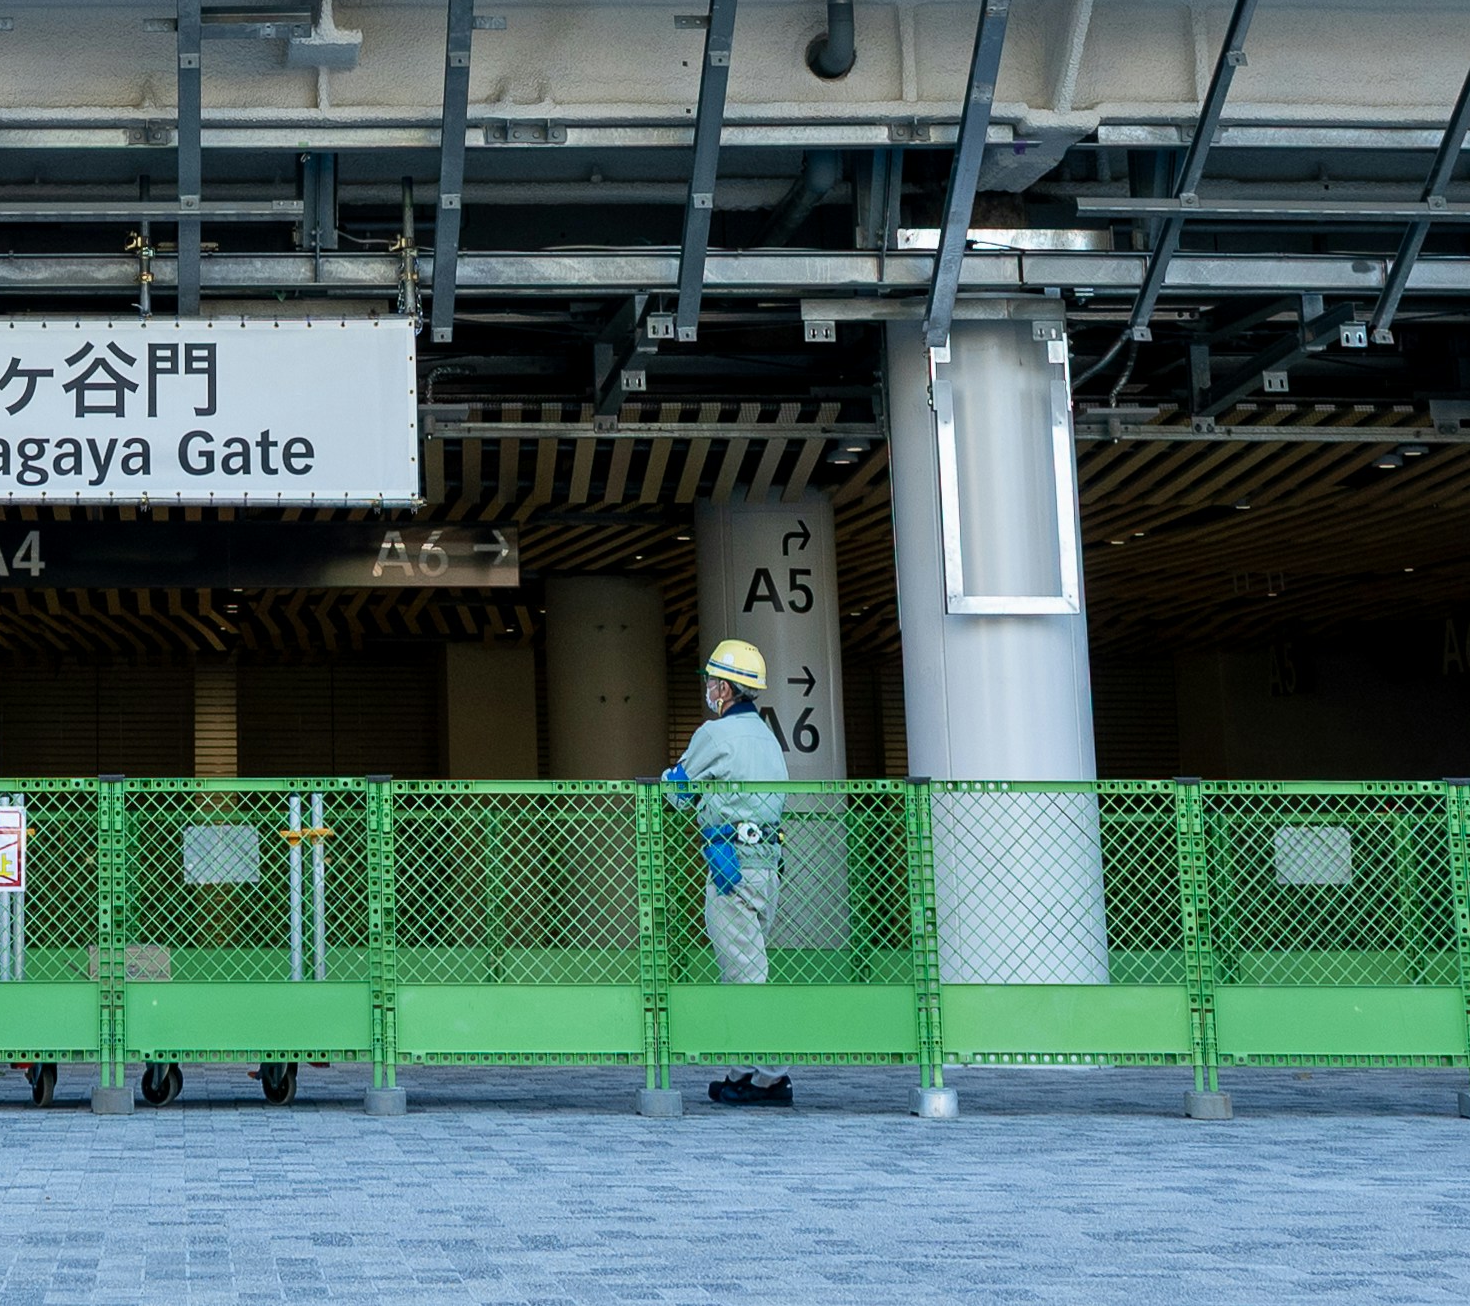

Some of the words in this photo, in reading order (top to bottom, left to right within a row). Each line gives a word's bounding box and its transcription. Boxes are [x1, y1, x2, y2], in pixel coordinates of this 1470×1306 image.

[177, 429, 315, 477] Gate
[372, 531, 449, 577] A6
[742, 568, 814, 614] A5
